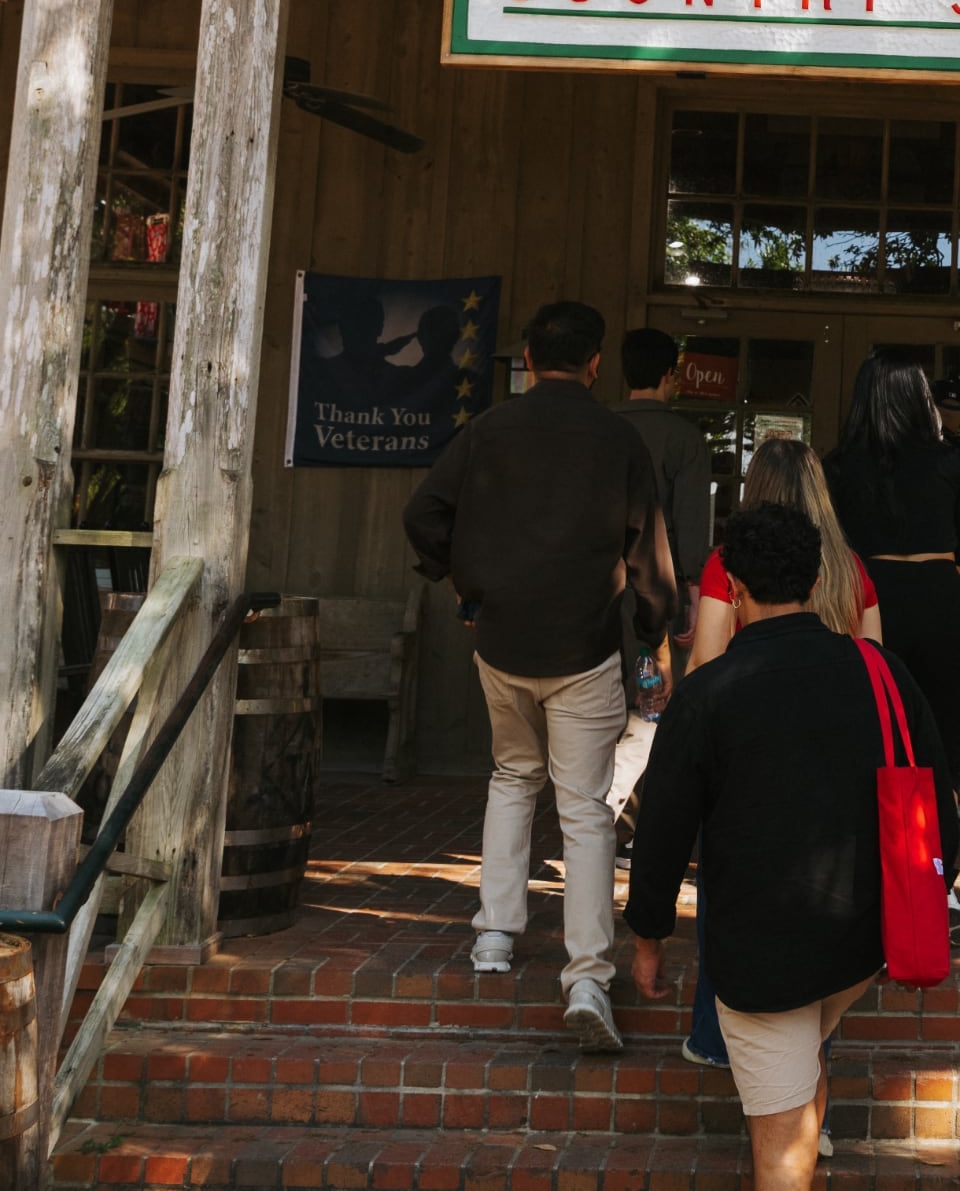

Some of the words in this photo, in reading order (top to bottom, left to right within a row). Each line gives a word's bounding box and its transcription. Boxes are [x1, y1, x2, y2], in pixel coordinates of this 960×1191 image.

[686, 362, 726, 389] Open
[315, 403, 384, 424] Thank
[391, 410, 432, 425] You
[314, 425, 430, 451] Veterans
